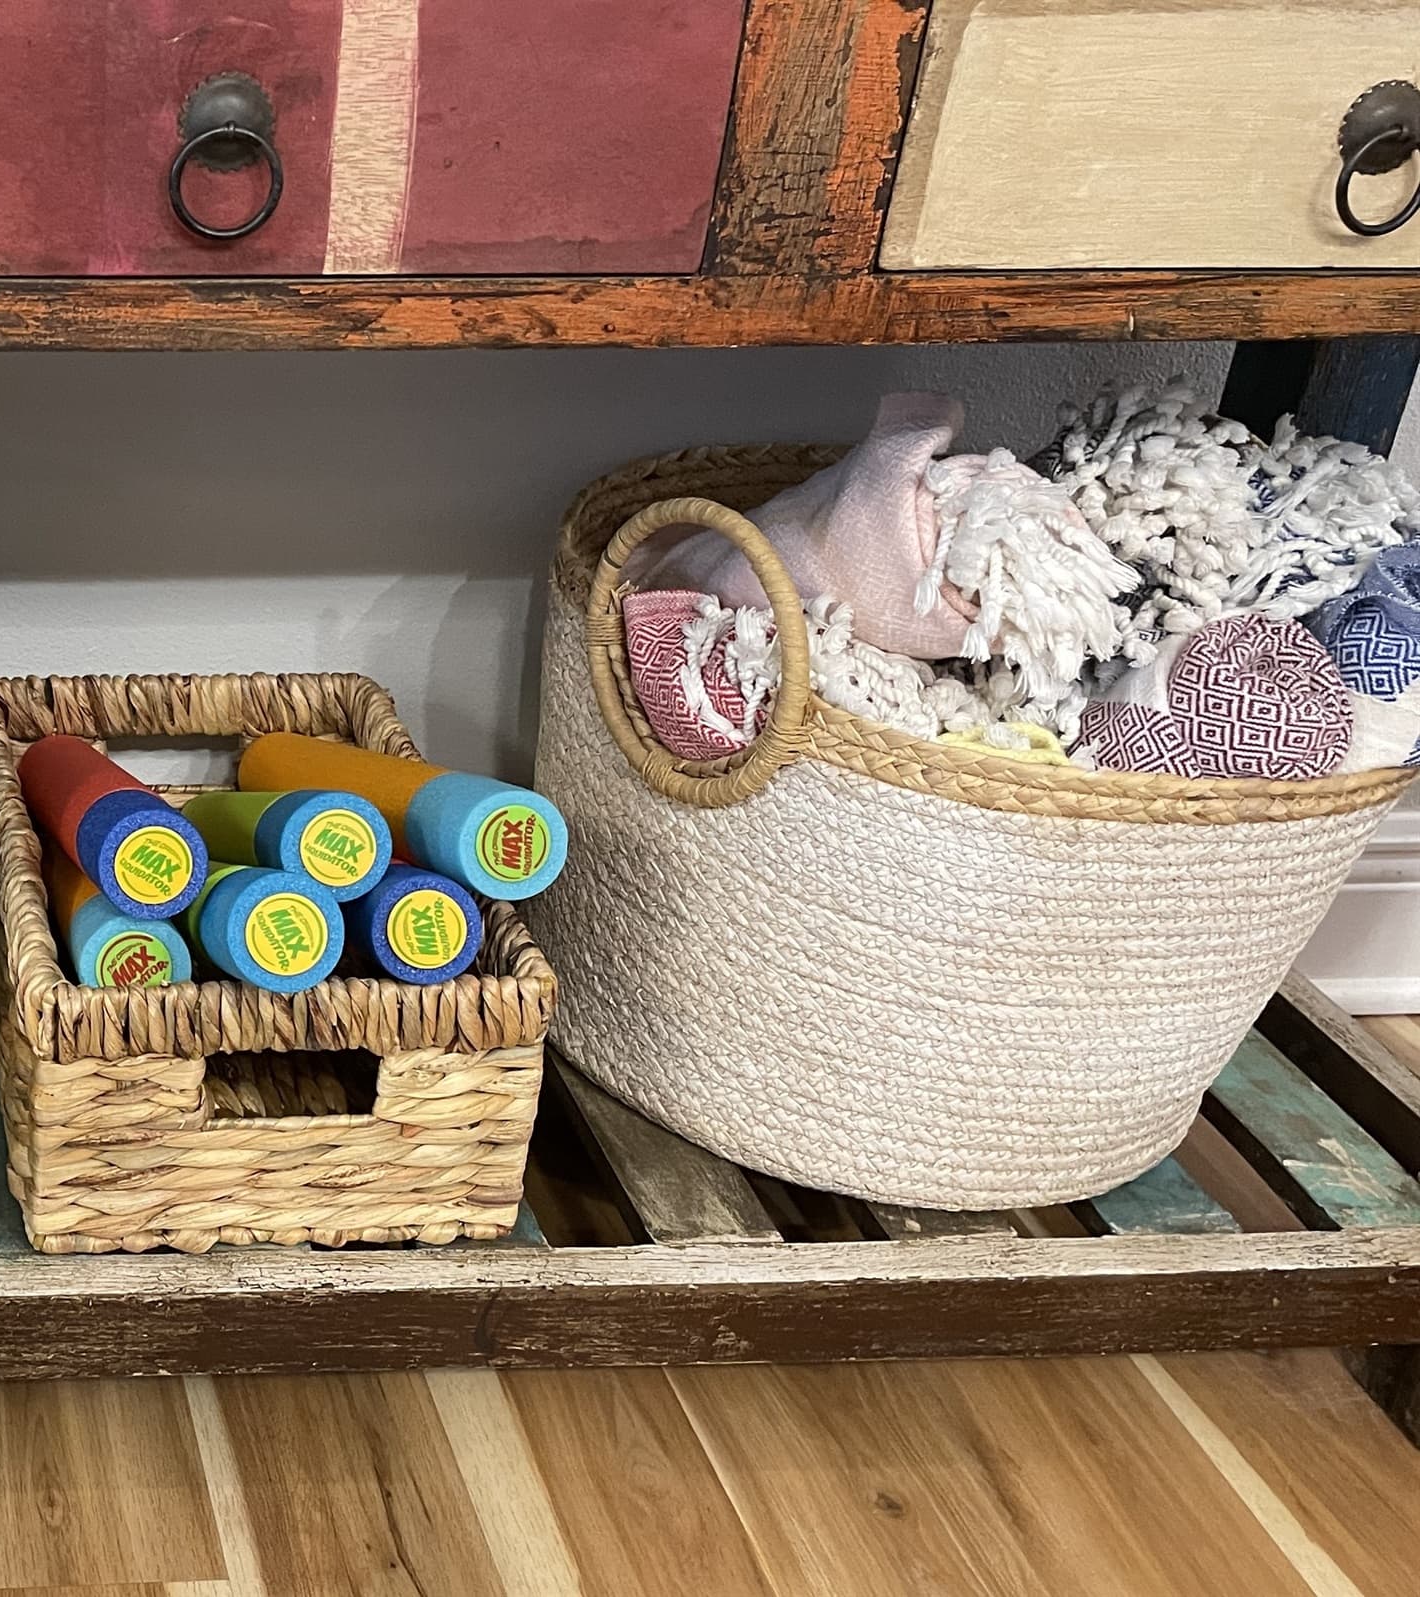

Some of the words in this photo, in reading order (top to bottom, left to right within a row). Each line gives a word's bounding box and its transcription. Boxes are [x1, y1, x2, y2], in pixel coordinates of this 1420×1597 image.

[130, 845, 181, 882] MAX
[304, 843, 358, 877] LIQUIDATOR
[314, 828, 366, 863] MAX
[502, 820, 523, 869] MAX
[523, 814, 537, 876] LIQUIDATOR
[120, 857, 171, 896] LIQUIDATOR
[256, 911, 290, 971] LIQUIDATOR
[267, 908, 310, 959] MAX
[411, 905, 439, 955] MAX
[434, 897, 451, 960] LIQUIDATOR
[111, 945, 156, 989] MAX
